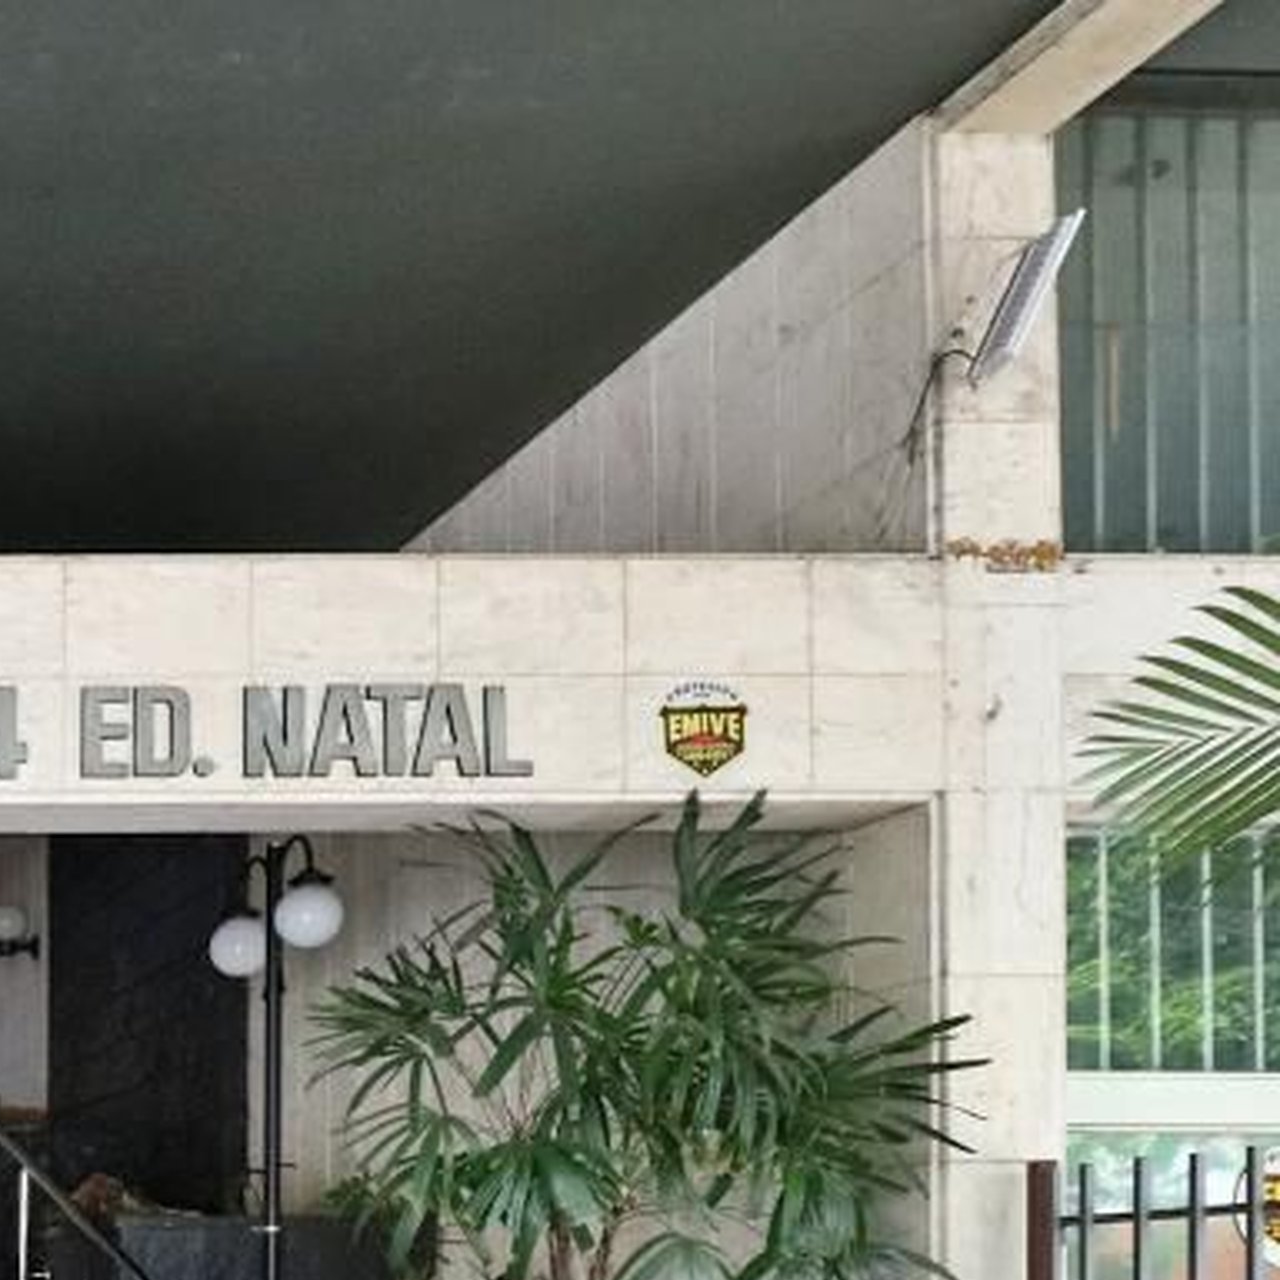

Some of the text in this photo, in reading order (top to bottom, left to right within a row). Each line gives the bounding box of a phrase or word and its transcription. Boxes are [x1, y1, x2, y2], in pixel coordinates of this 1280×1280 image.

[79, 686, 215, 779] ED.
[243, 683, 534, 778] NATAL
[668, 711, 742, 742] EMIVE
